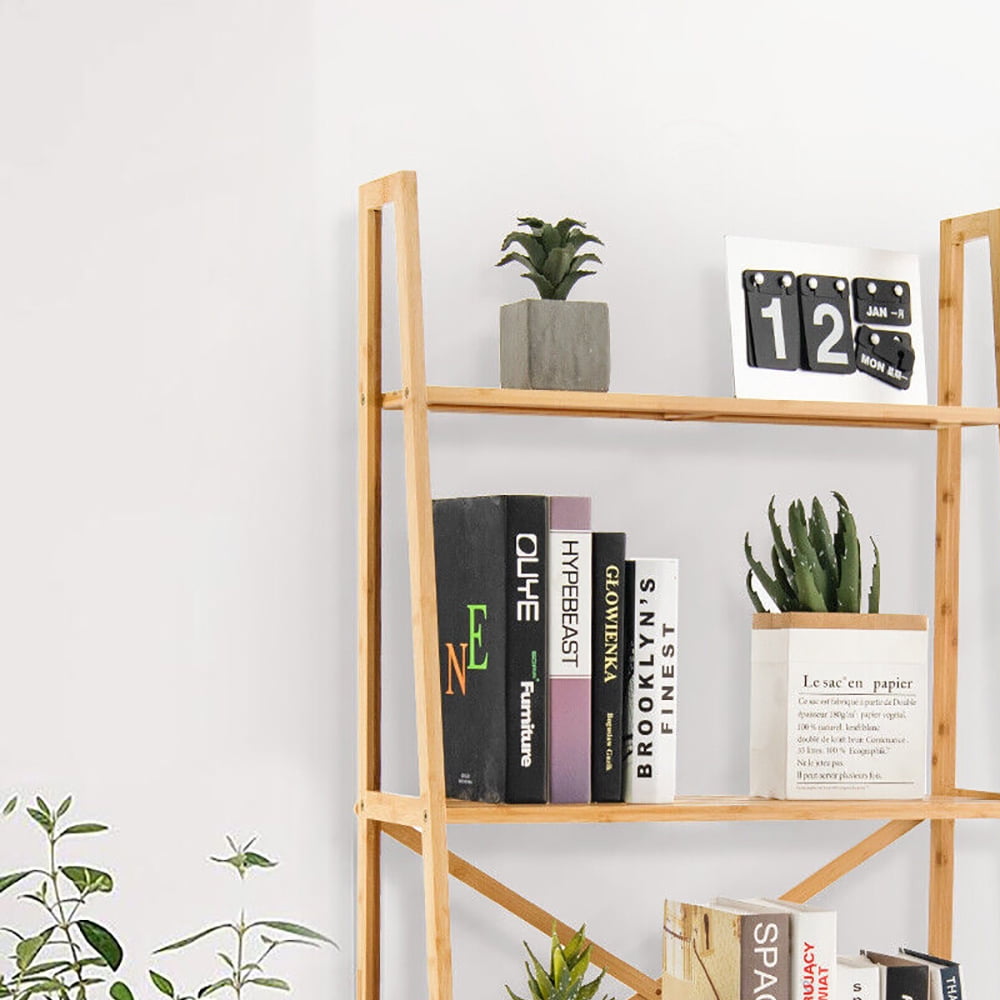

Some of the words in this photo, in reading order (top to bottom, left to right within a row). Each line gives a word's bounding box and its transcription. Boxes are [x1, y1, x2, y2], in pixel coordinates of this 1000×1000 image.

[866, 305, 887, 318] JAN
[860, 353, 885, 374] MON
[516, 533, 540, 622] OUYE
[562, 540, 579, 668] HYPEBEAST
[603, 564, 620, 683] GŁOWIENKA
[661, 623, 675, 734] FINEST
[803, 674, 820, 688] Le
[848, 679, 863, 688] en
[873, 676, 913, 693] papier
[520, 681, 535, 768] Furniture
